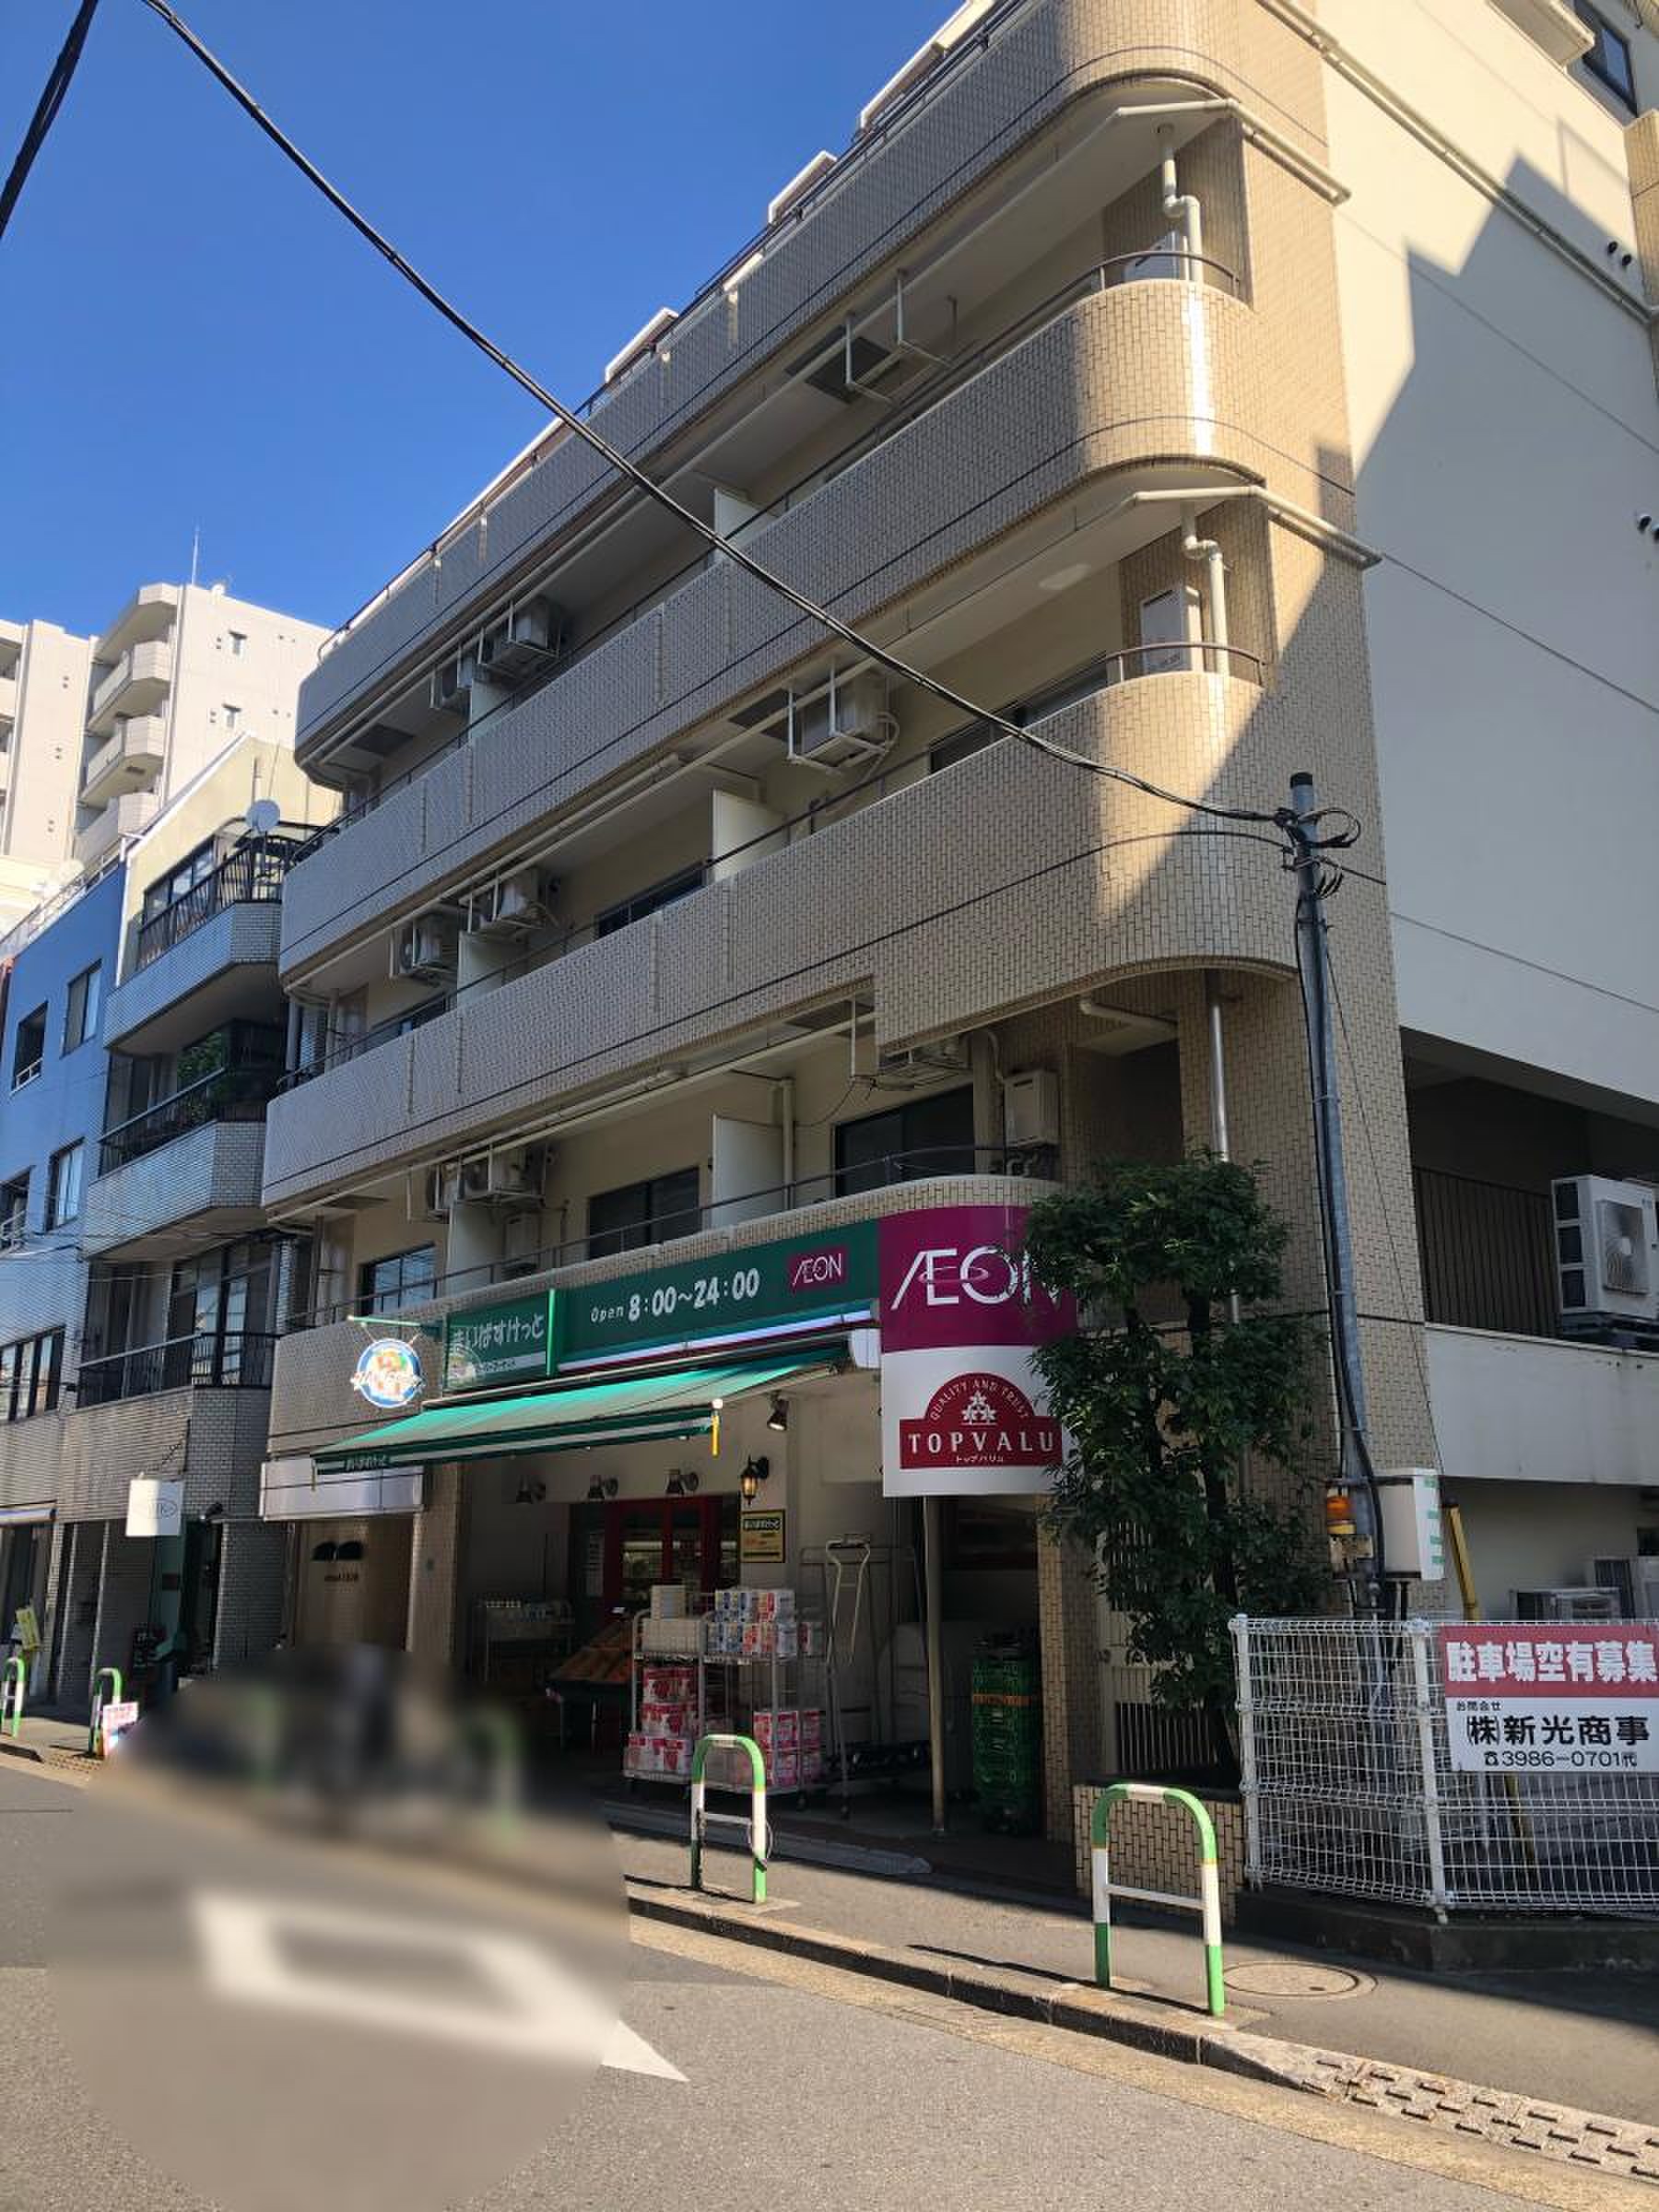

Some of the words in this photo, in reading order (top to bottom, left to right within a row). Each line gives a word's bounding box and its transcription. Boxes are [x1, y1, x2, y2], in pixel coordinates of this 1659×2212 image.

[590, 1305, 624, 1324] Open
[929, 1382, 967, 1421] QUALITY
[971, 1380, 998, 1392] AND
[1002, 1386, 1030, 1418] TRUST
[908, 1431, 1054, 1454] TOPVALU
[1445, 1640, 1658, 1682] 駐車場空有募集
[1455, 1700, 1501, 1712] お問合せ
